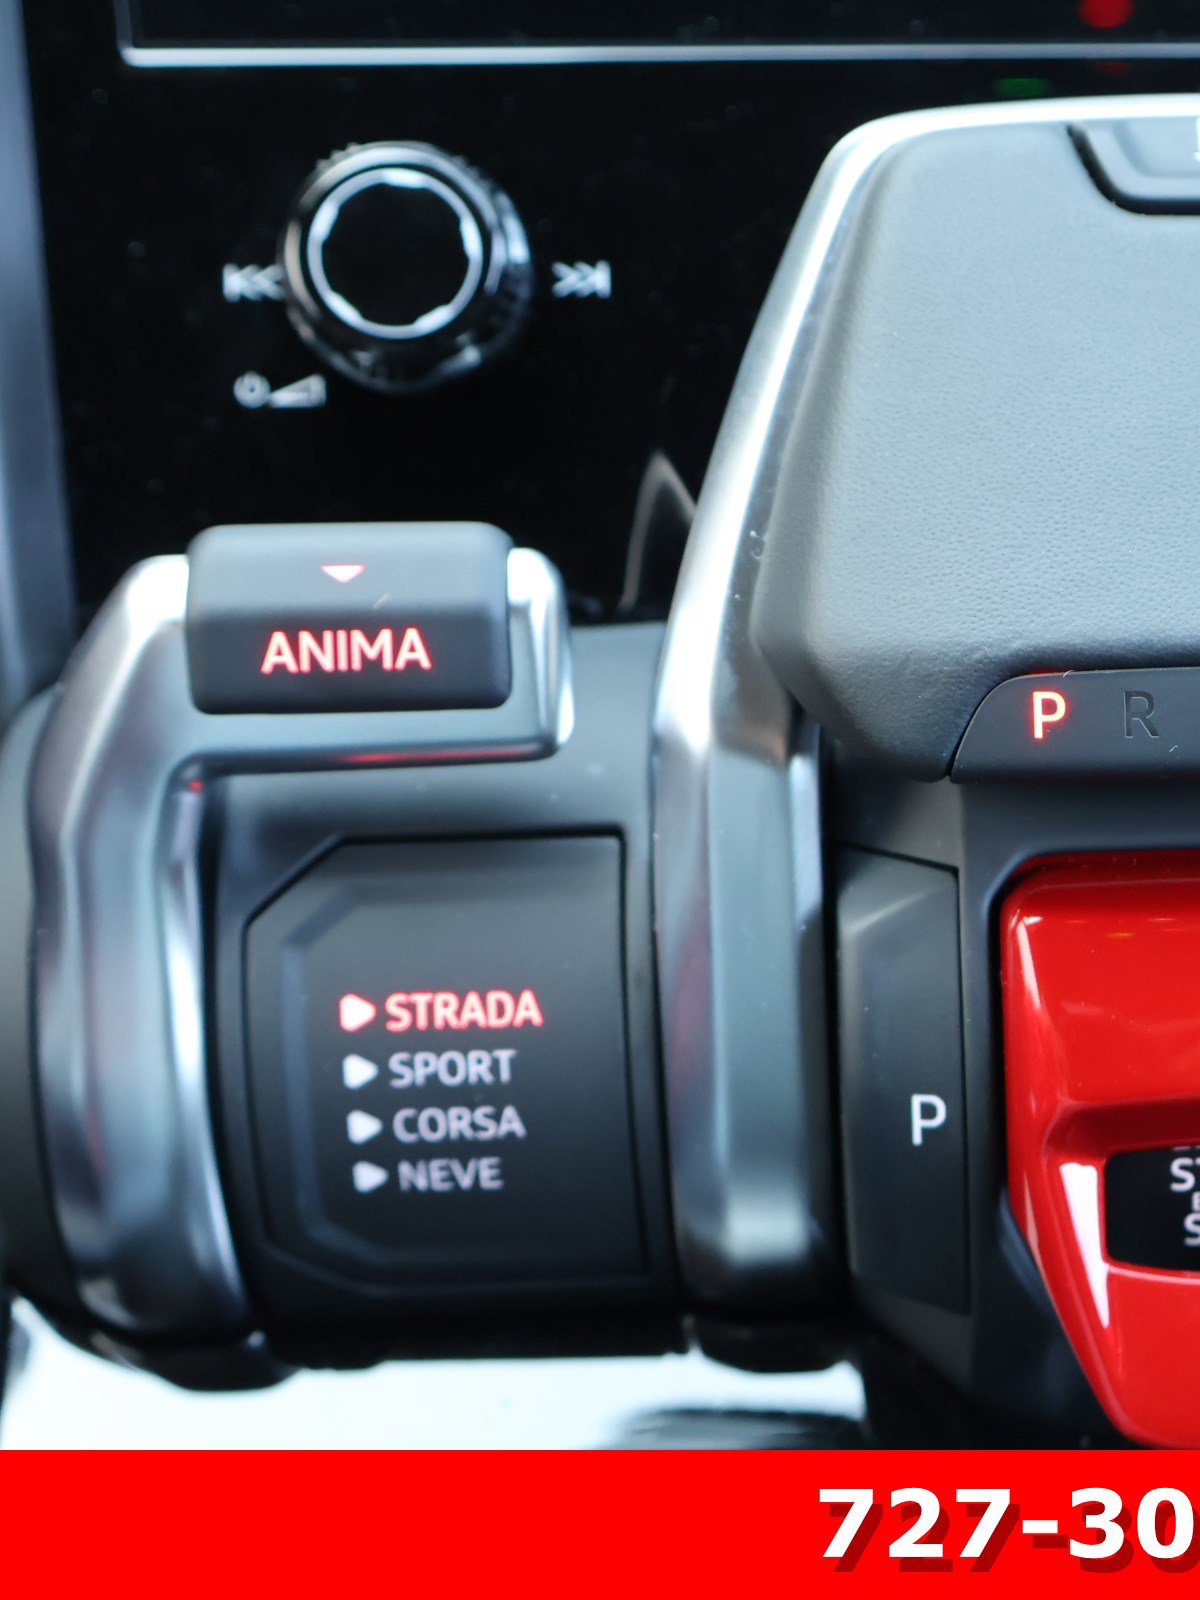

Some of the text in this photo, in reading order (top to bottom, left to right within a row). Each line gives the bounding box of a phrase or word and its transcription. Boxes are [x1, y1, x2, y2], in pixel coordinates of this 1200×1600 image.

[261, 626, 432, 674] ANIMA
[1031, 690, 1067, 739] P
[1123, 690, 1160, 739] R
[385, 989, 544, 1033] STRADA
[388, 1049, 517, 1089] SPORT
[393, 1104, 527, 1144] CORSA
[911, 1093, 946, 1146] P
[398, 1156, 504, 1192] NEVE
